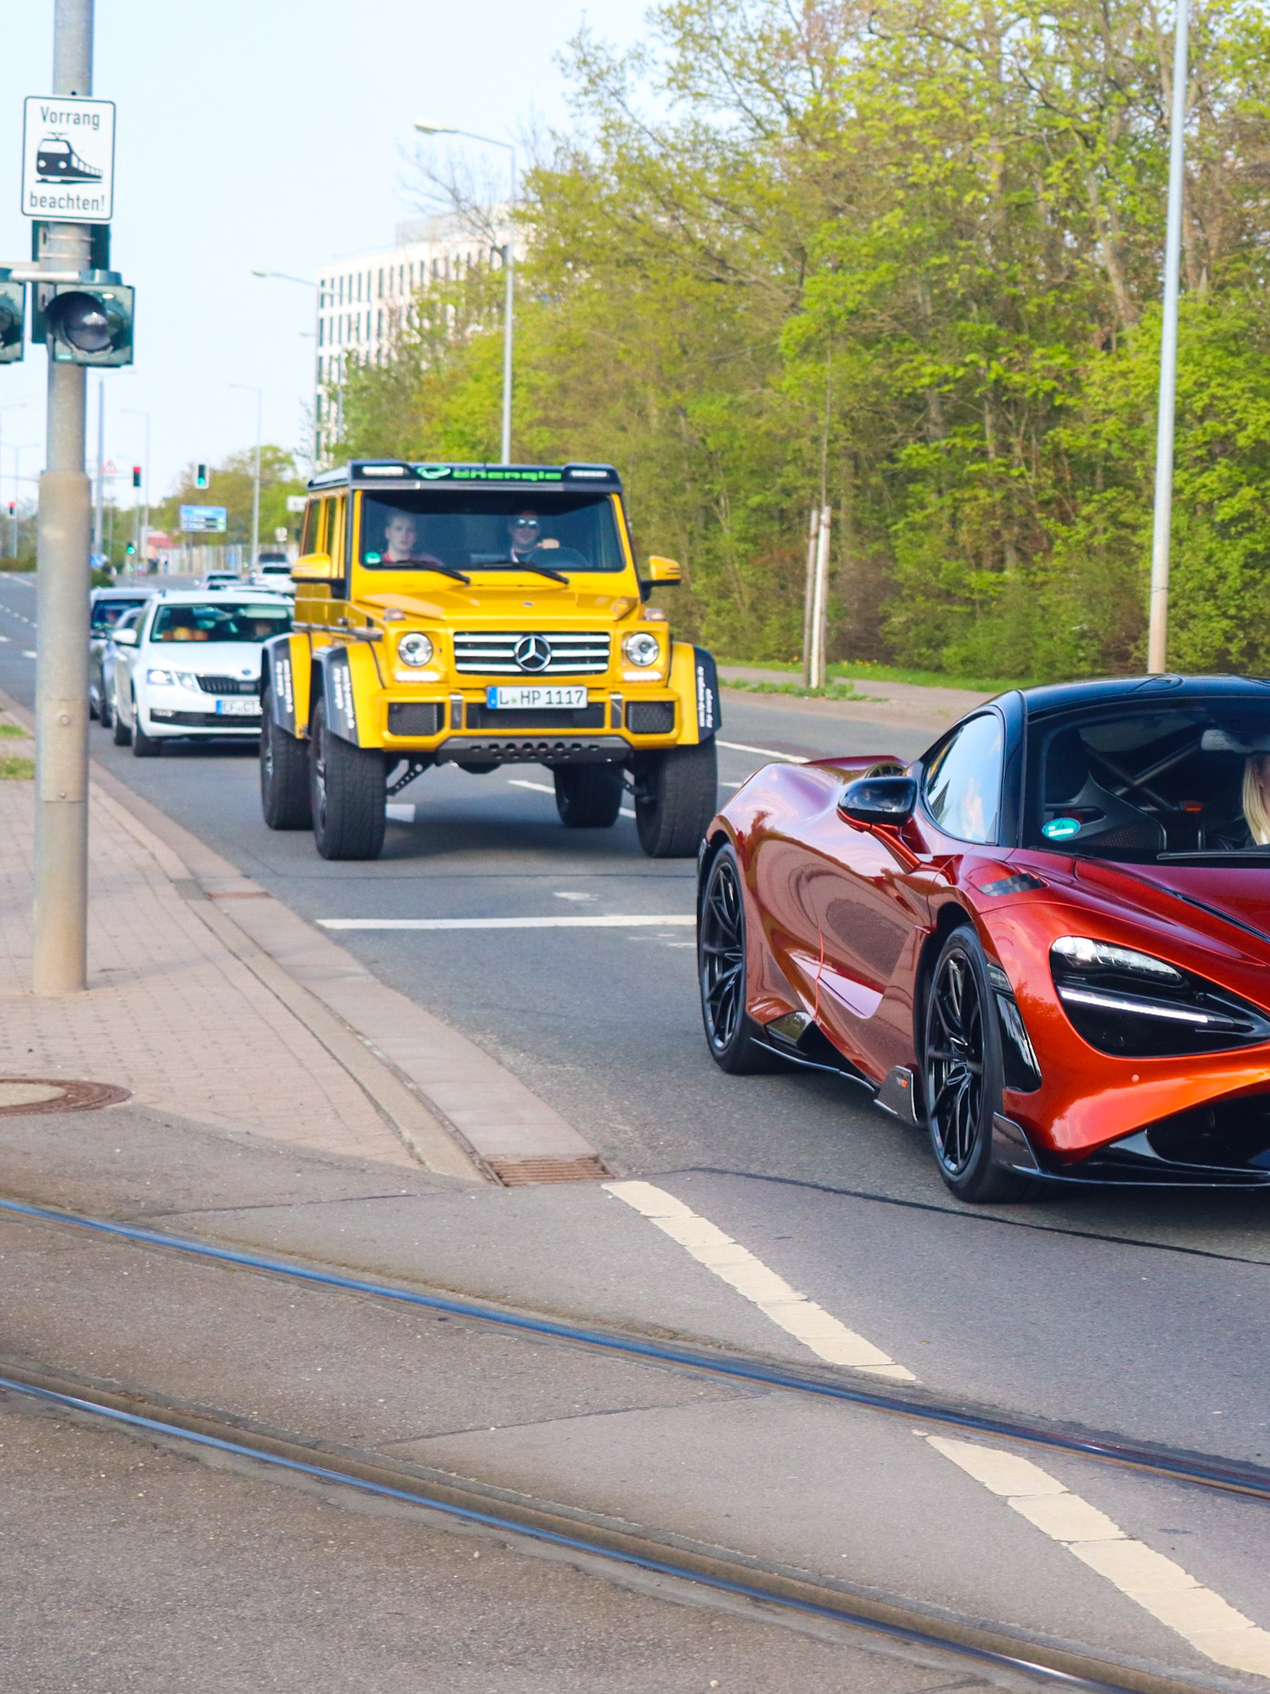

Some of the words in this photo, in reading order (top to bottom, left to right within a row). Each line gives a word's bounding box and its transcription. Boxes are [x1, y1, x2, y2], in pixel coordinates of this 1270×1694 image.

[40, 106, 100, 131] Vorrang
[30, 191, 105, 211] beachten!
[499, 690, 509, 705] L
[520, 690, 541, 705] HP
[545, 690, 584, 705] 1117
